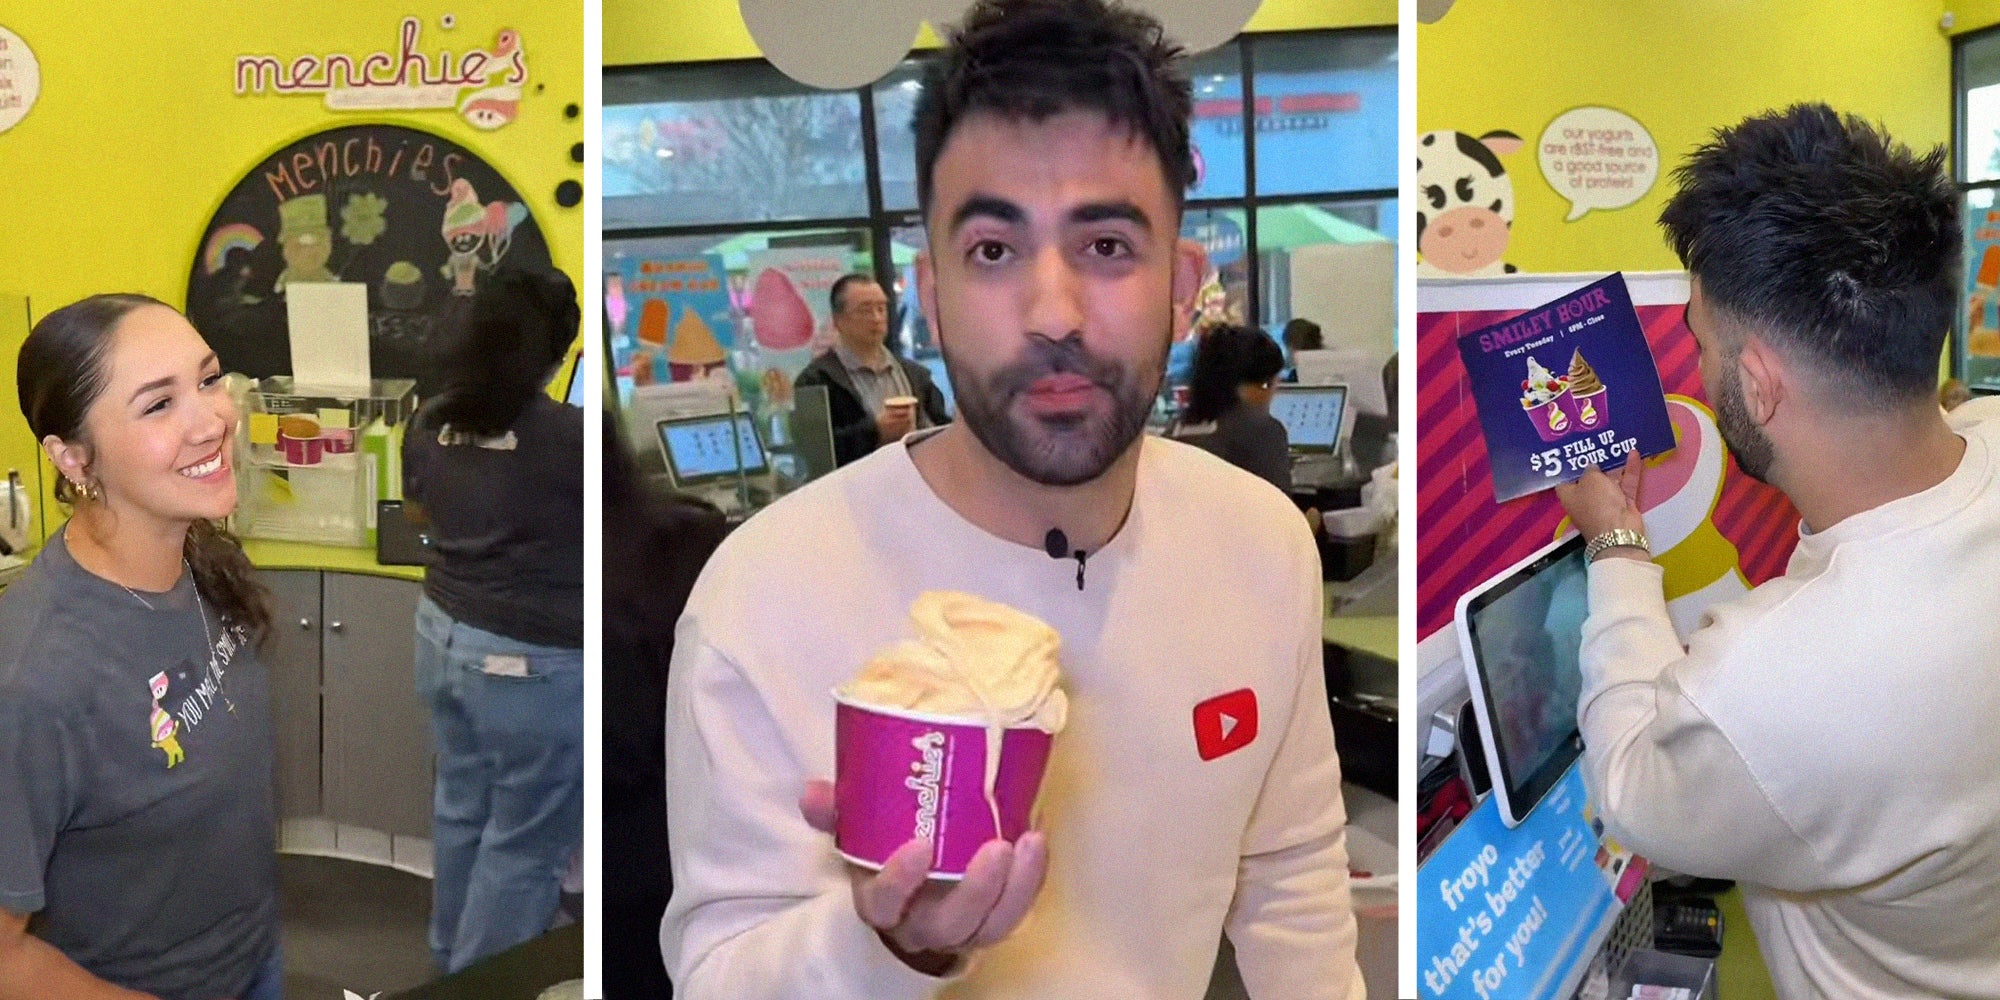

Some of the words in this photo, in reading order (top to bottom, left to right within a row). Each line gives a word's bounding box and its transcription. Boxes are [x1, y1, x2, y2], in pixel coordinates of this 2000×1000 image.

[1544, 144, 1567, 155] are
[1628, 146, 1652, 158] and
[1554, 161, 1563, 171] a
[1567, 161, 1602, 174] good
[1569, 175, 1583, 188] of
[1479, 310, 1554, 352] SMILEY
[1556, 288, 1611, 323] HOUR
[1504, 344, 1525, 358] Every
[1525, 334, 1554, 349] Tuesday
[1586, 313, 1605, 326] Close
[1530, 448, 1562, 478] $5
[1563, 438, 1596, 457] FILL
[1598, 430, 1615, 445] UP
[1567, 448, 1609, 471] YOUR
[1610, 437, 1637, 457] CUP
[177, 695, 203, 733] YOU
[905, 731, 944, 842] enchie's
[1440, 844, 1498, 912] froyo
[1424, 910, 1493, 996] that's
[1484, 840, 1545, 918] better
[1472, 952, 1508, 1000] for
